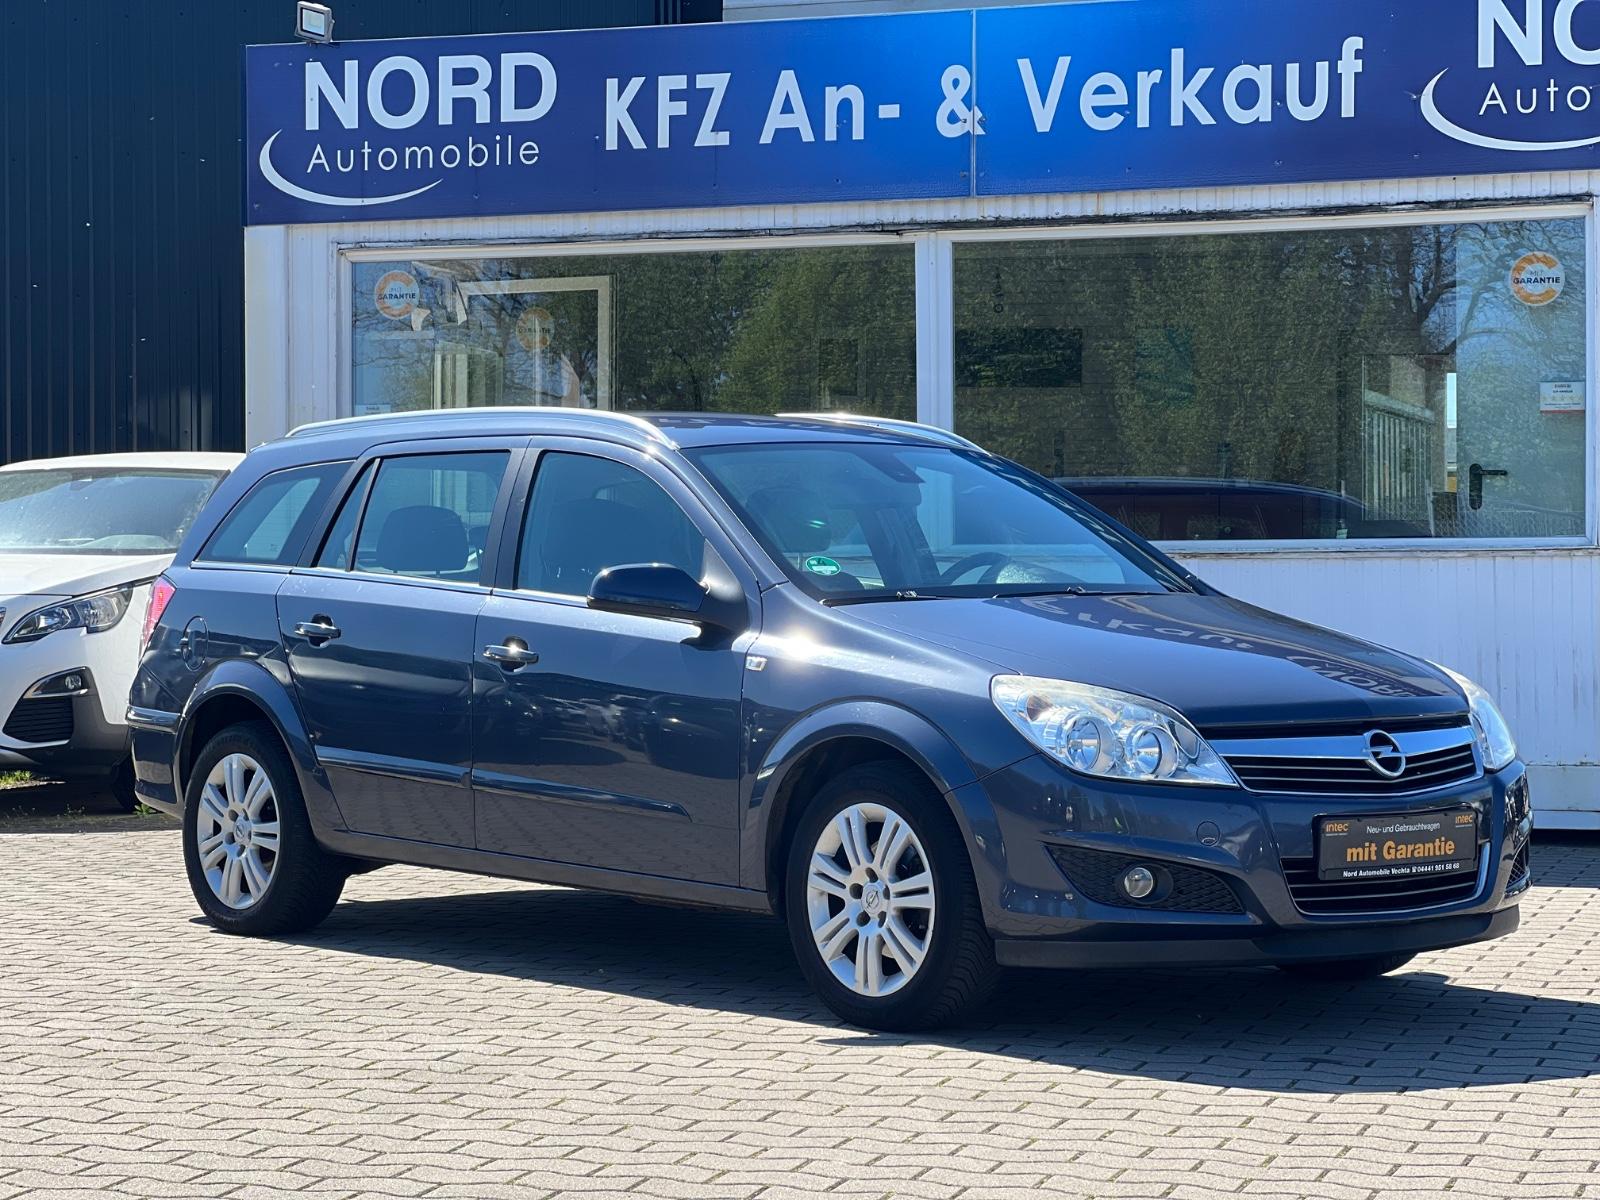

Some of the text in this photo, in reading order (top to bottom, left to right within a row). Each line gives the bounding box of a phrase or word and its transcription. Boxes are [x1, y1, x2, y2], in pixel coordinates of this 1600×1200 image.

[1478, 0, 1600, 68] NO
[304, 52, 558, 131] NORD
[605, 36, 1364, 151] KFZ An- & Verkauf
[1478, 79, 1592, 116] Auto
[306, 134, 540, 173] Automobile
[1513, 276, 1561, 285] GARANTIE
[377, 292, 416, 300] GARANTIE
[1326, 822, 1349, 833] intec
[1366, 822, 1441, 835] Neu- und Gebrauchtwagen
[1455, 815, 1473, 825] intec
[1346, 836, 1455, 862] mit Garantie
[1343, 870, 1358, 878] Nord
[1358, 868, 1390, 877] Automobile
[1391, 866, 1410, 875] Vechta
